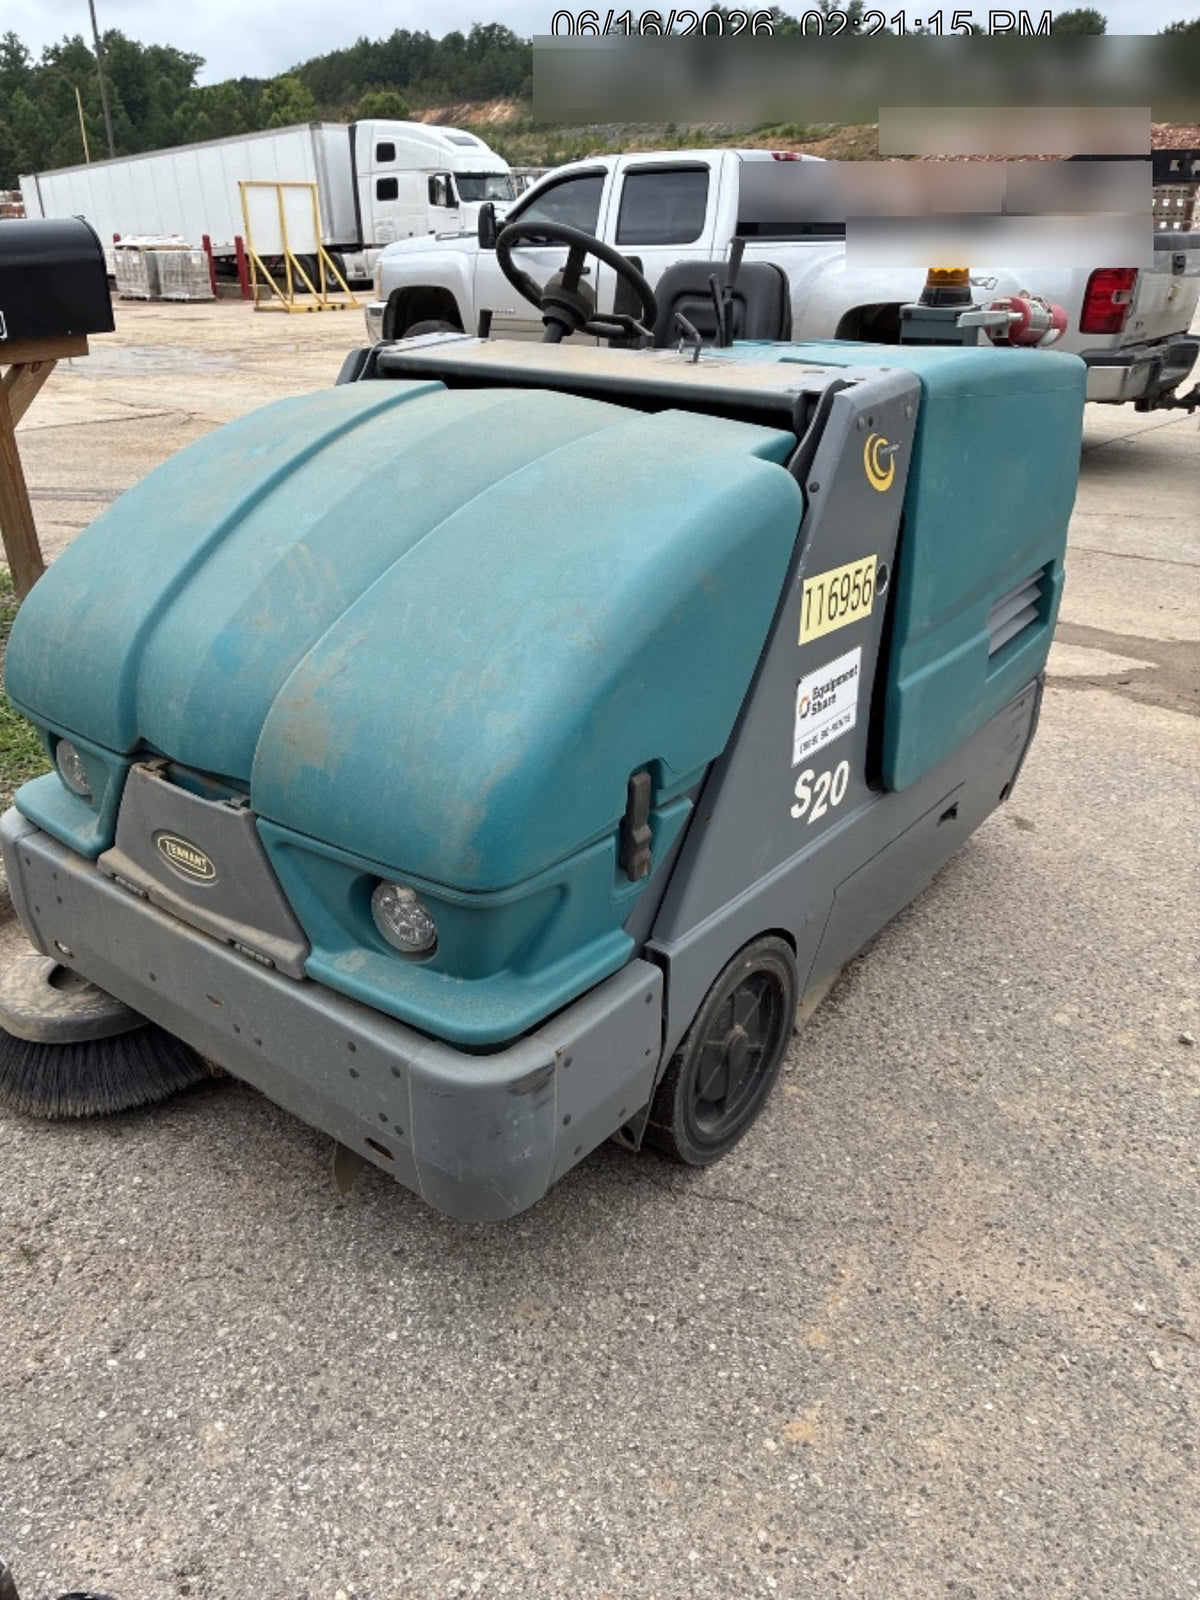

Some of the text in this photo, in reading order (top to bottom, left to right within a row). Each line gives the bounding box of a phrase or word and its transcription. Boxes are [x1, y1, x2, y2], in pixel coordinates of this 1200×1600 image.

[805, 564, 873, 631] 116956
[791, 760, 849, 825] S20
[165, 840, 208, 874] TENNANT
